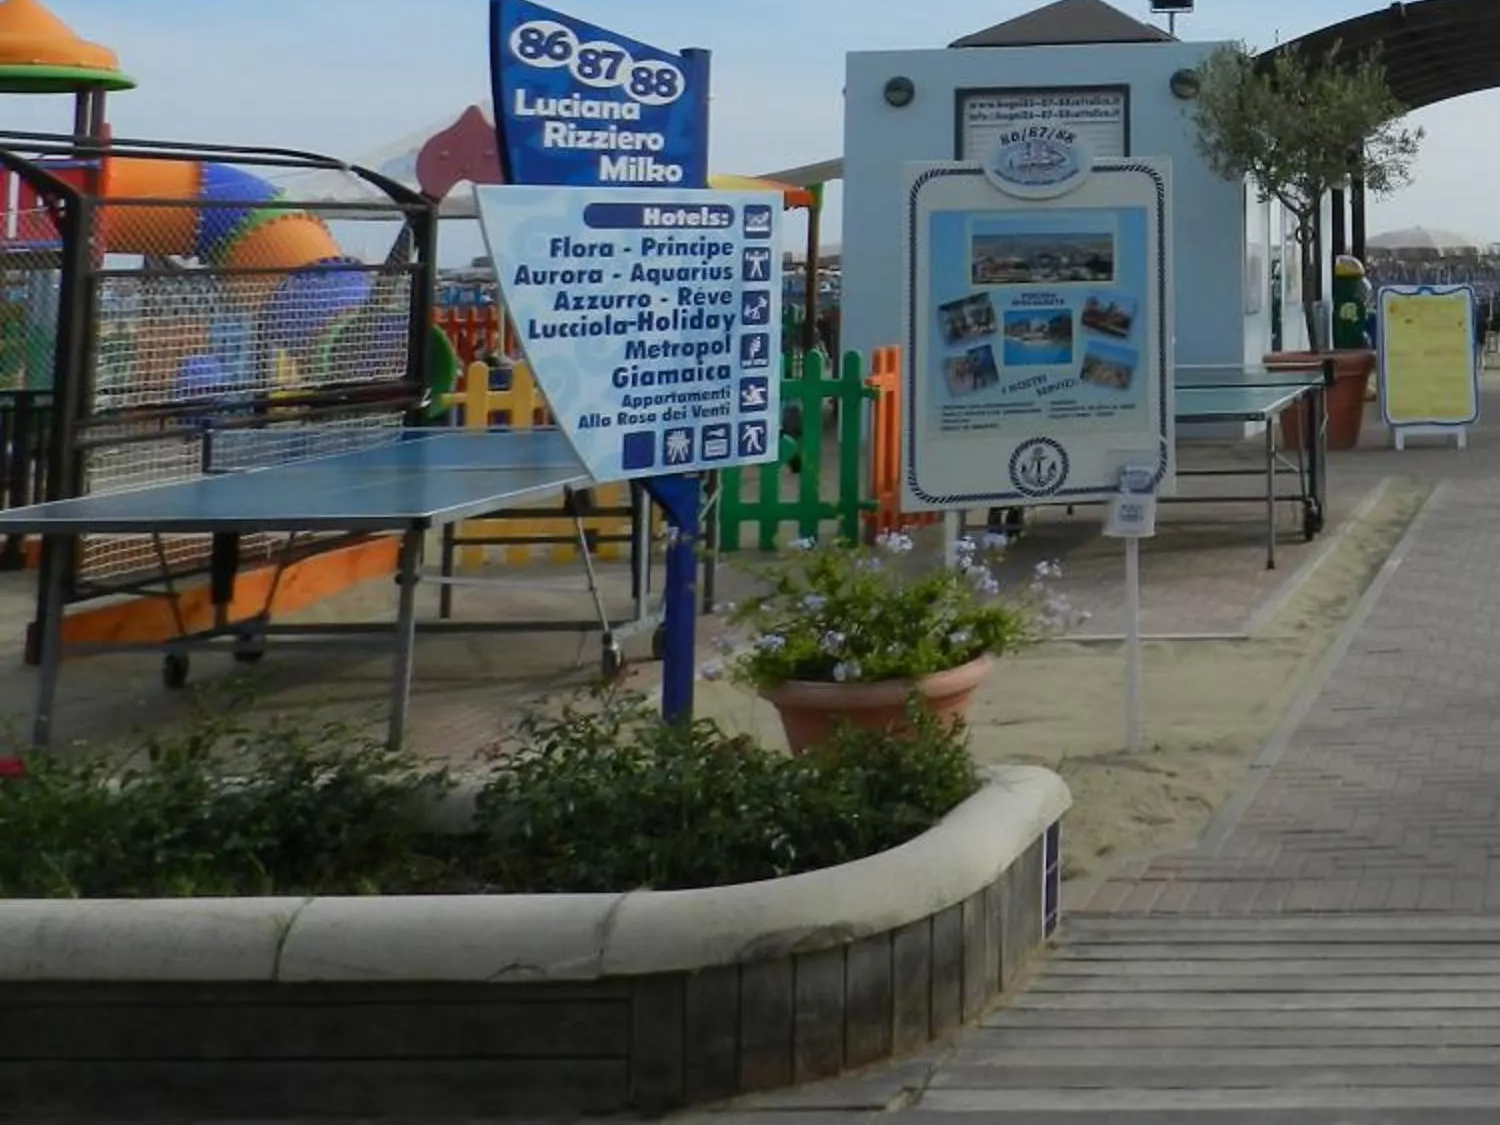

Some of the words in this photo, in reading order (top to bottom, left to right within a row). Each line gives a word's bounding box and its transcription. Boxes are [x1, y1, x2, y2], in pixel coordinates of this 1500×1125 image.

[517, 27, 573, 62] 86
[577, 48, 626, 80] 87
[630, 66, 679, 98] 88
[514, 88, 641, 120] Luciana
[543, 121, 665, 151] Rizziero
[599, 155, 683, 183] Milko
[643, 207, 729, 226] Hotels:
[550, 236, 614, 258] Flora
[641, 236, 734, 260] Principe
[514, 264, 603, 285] Aurora
[630, 261, 734, 285] Aquarius
[553, 291, 651, 311] Azzurro
[624, 334, 731, 361] Metropol
[612, 361, 731, 388] Giamaica
[621, 385, 731, 409] Appartamenti
[617, 411, 657, 426] Rosa
[663, 406, 687, 421] dei
[692, 401, 731, 418] Venti
